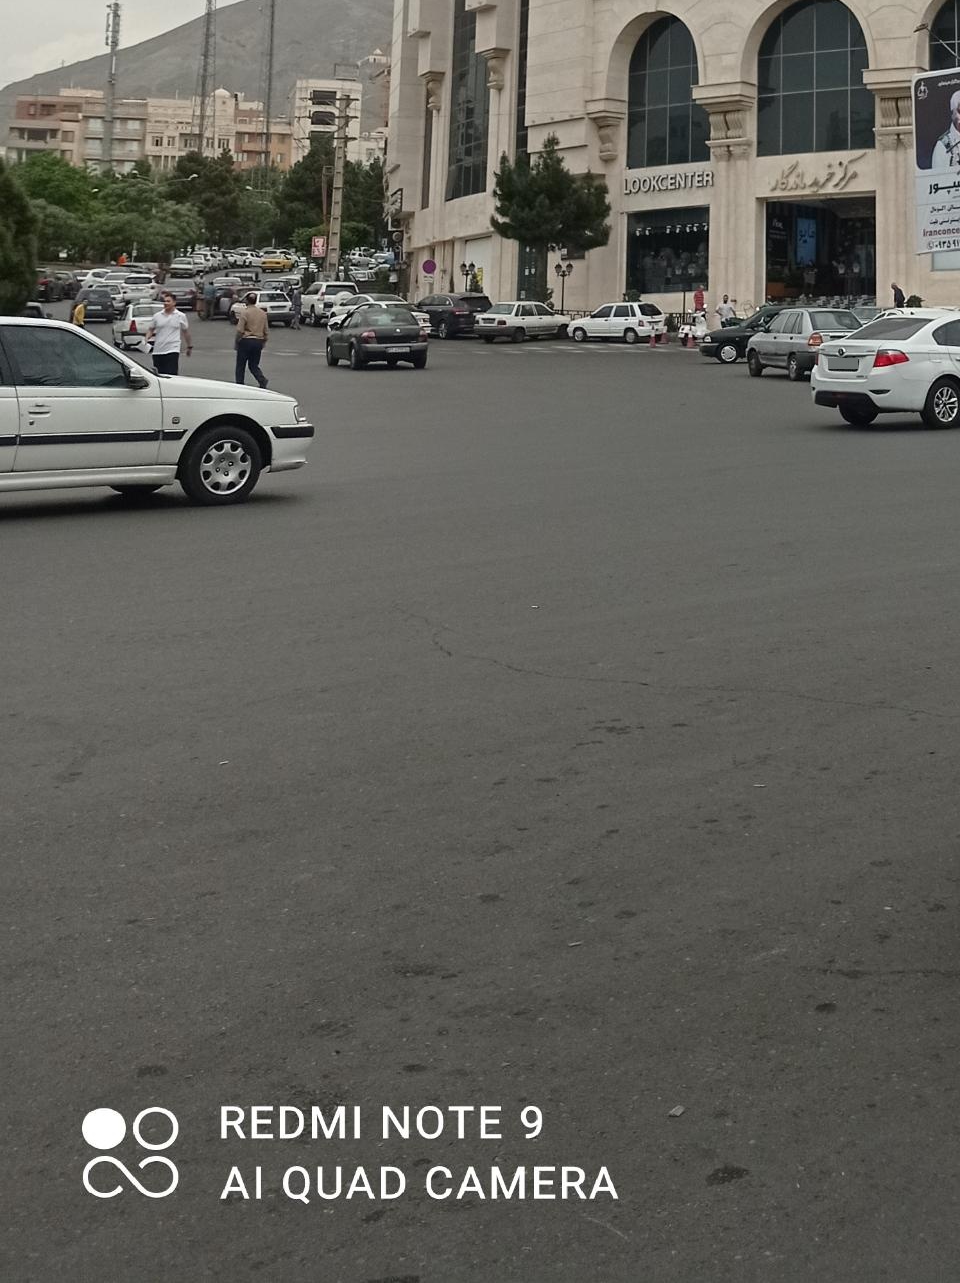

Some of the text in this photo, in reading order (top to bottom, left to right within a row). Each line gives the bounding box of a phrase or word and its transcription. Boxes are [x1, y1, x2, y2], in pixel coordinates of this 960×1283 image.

[624, 171, 716, 195] LOOKCENTER
[808, 163, 836, 194] خرید
[833, 151, 867, 191] مرکز
